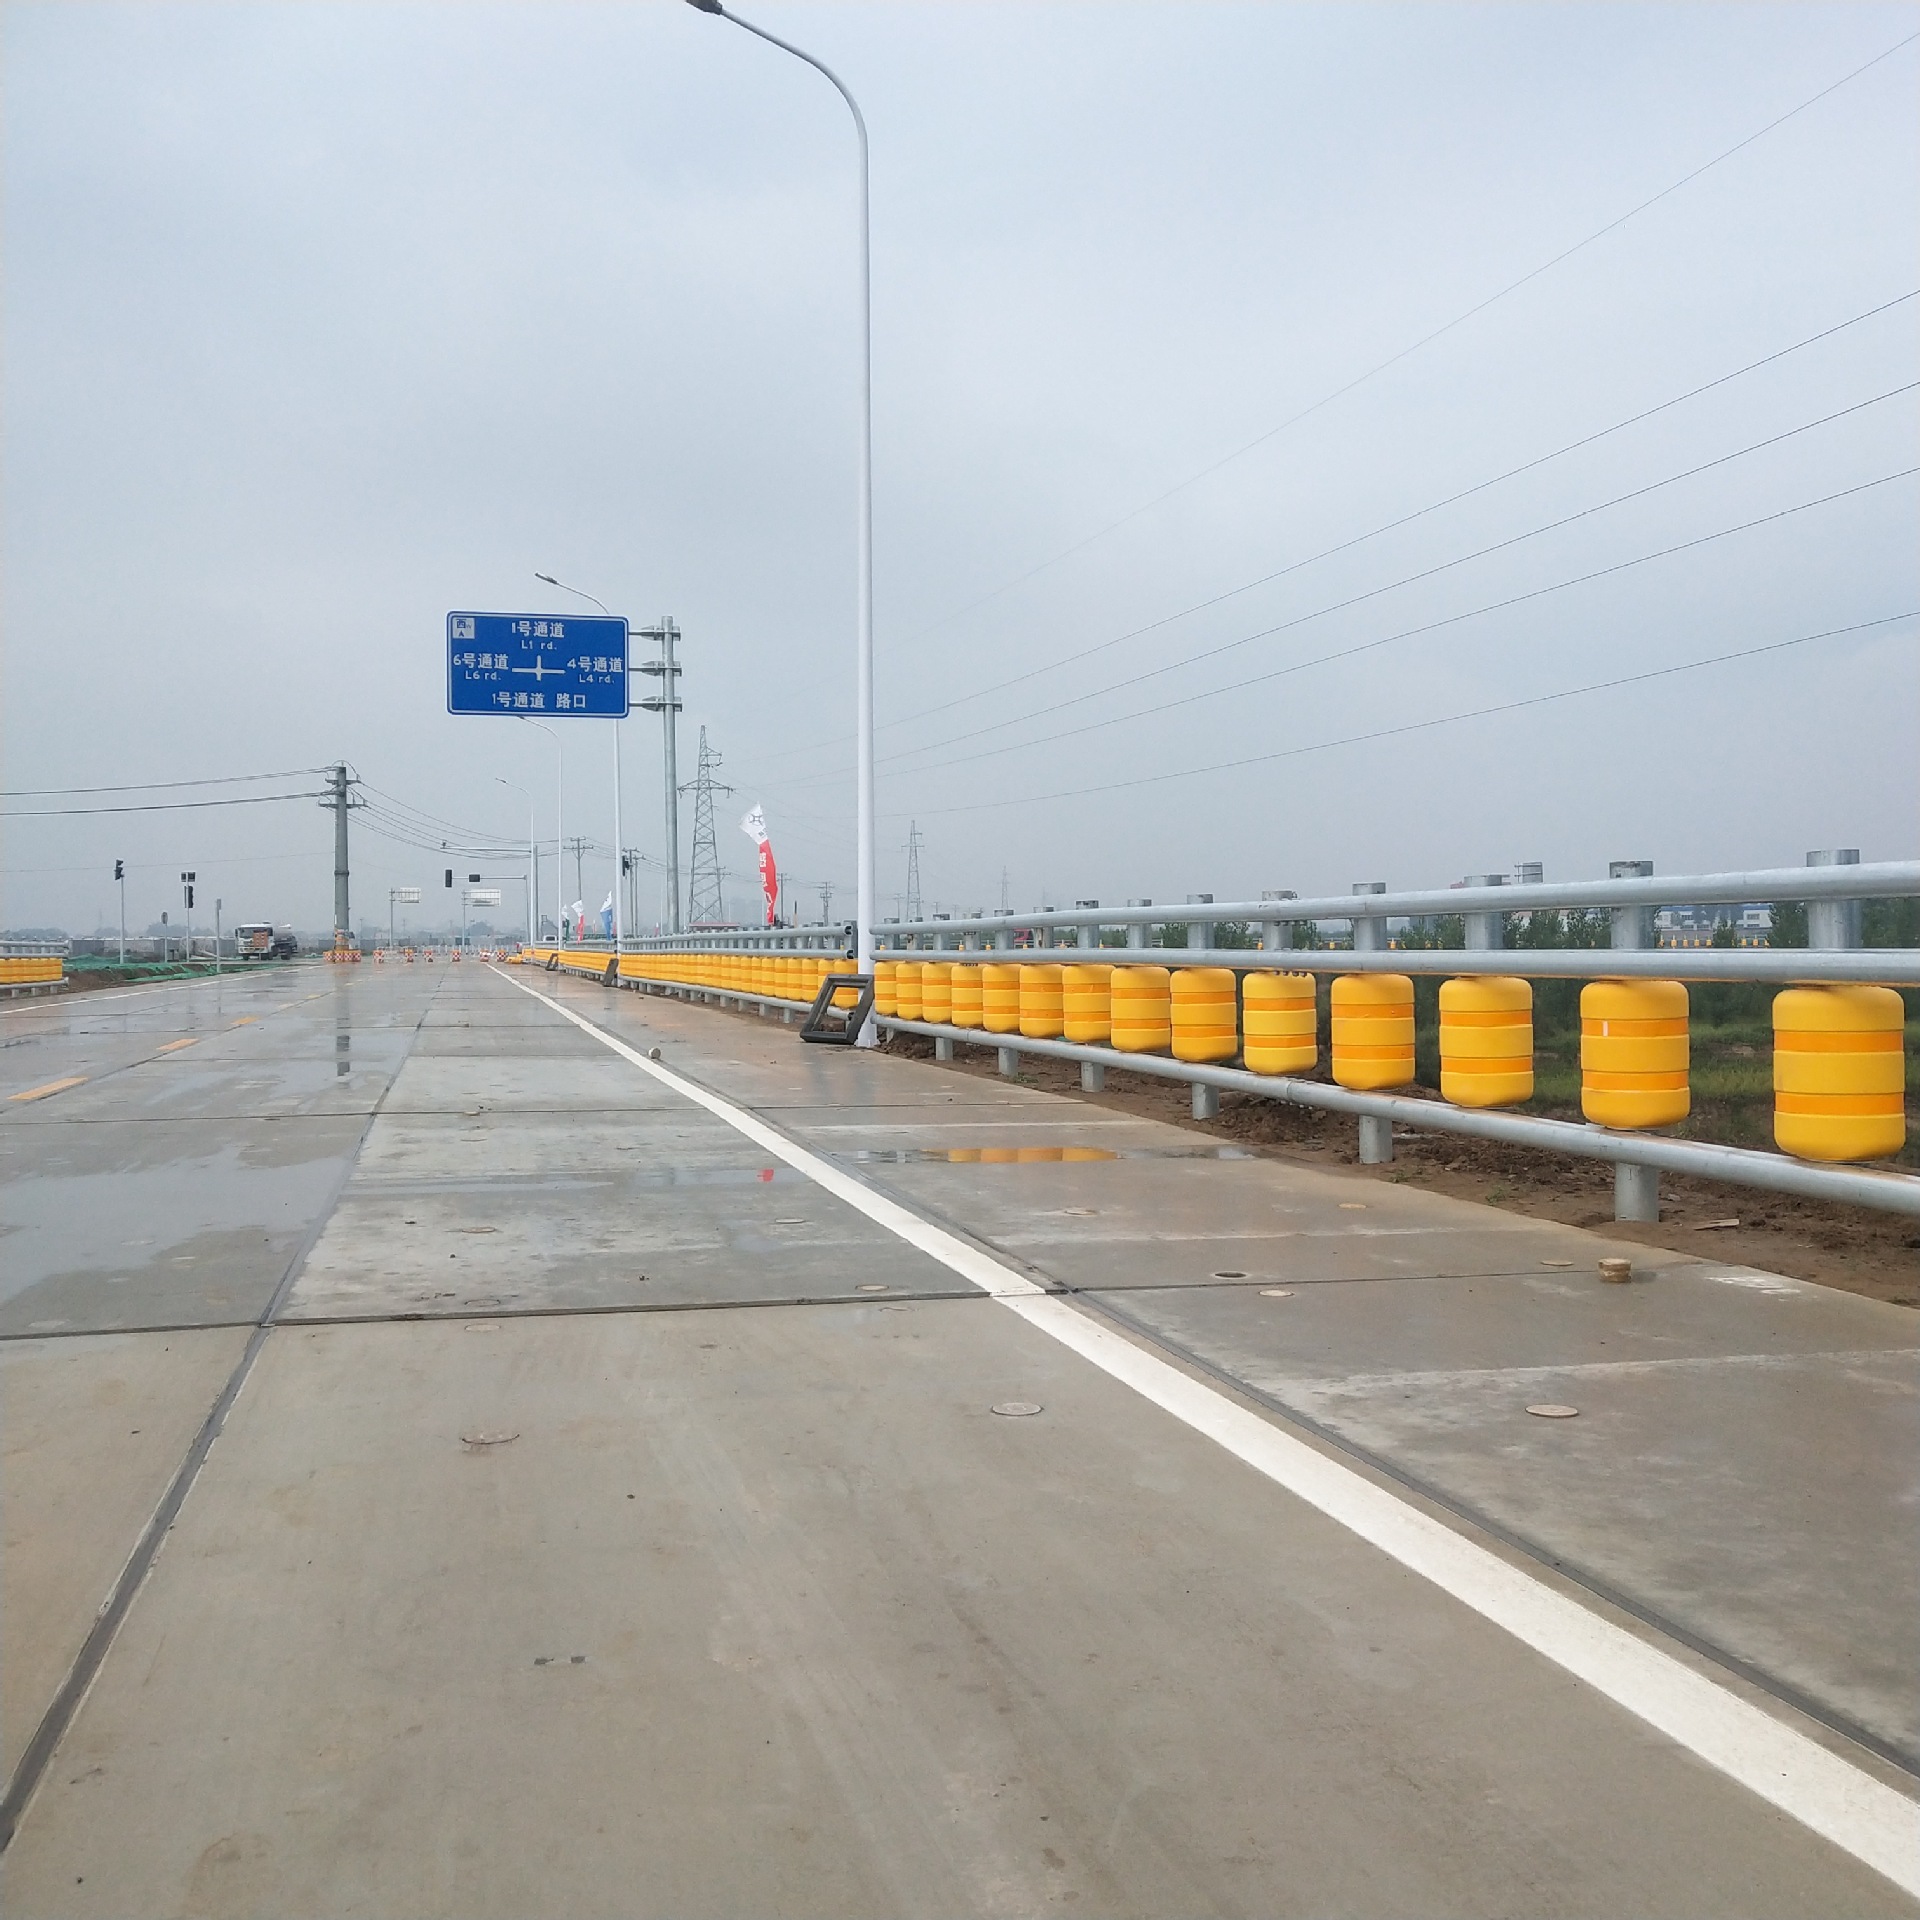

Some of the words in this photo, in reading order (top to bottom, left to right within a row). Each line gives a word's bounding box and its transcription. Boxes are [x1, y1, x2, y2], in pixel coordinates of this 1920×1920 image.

[511, 620, 565, 638] 1号通道
[521, 639, 533, 650] L1
[540, 641, 557, 650] rd.
[453, 652, 509, 670] 6号通道
[566, 655, 624, 673] 4号通道
[465, 670, 480, 680] L6
[484, 671, 501, 681] rd.
[579, 673, 594, 683] L4
[598, 674, 615, 684] rd.
[492, 691, 545, 709] 1号通道
[556, 692, 586, 709] 路口
